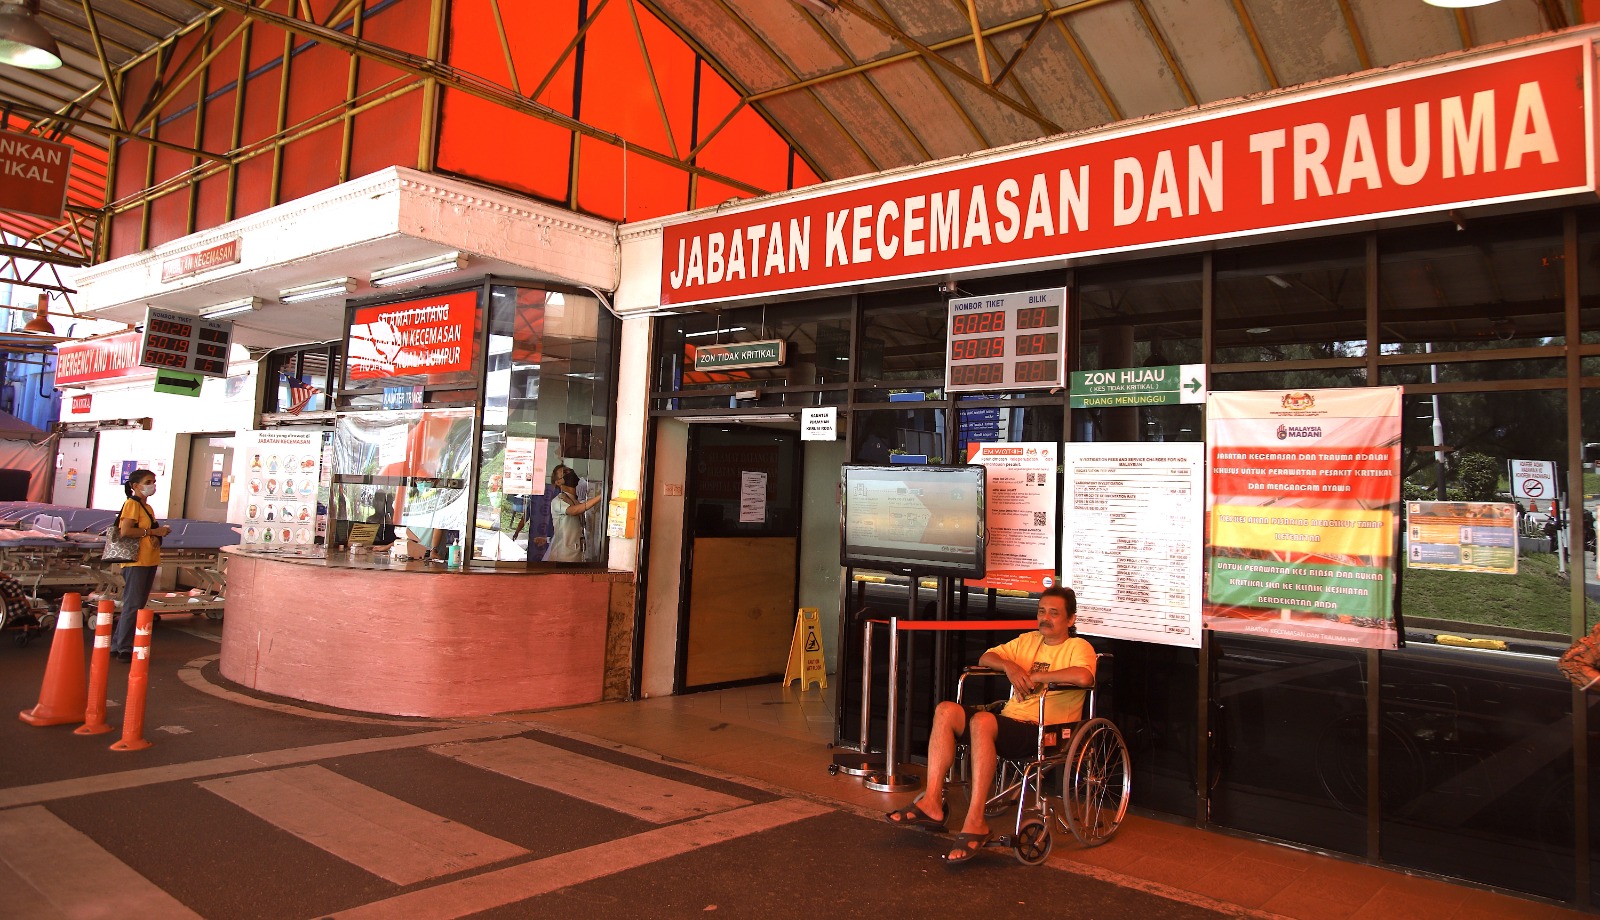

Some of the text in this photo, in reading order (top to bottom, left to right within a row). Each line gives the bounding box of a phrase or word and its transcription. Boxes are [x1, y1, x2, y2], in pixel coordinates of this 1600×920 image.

[669, 81, 1560, 290] JABATAN KECEMASAN DAN TRAUMA
[194, 245, 233, 268] KECEMASAN
[953, 295, 1047, 311] NOMBOR TIKET BILIK
[150, 319, 191, 337] 6028
[953, 311, 1005, 335] 6028
[409, 324, 462, 347] KECEMASAN
[147, 334, 217, 356] 5019 4
[953, 335, 1045, 359] 5019 4
[58, 341, 137, 378] EMERGENCY AND TRAUMA
[145, 350, 213, 372] 6023 6
[700, 349, 776, 363] ZON TIDAK KRITIKAL
[1084, 369, 1165, 386] ZON HIJAU
[1083, 395, 1166, 406] RUANG MENUNGGU
[1216, 452, 1389, 461] JABATAN KECEMASAN DAN TRAUMA ADALAH
[1268, 468, 1317, 476] PERAWATAN
[1354, 469, 1393, 477] KRITIKAL
[1248, 482, 1265, 490] DAN
[1267, 483, 1320, 491] MENGANCAM
[1271, 517, 1309, 526] DISARING
[1311, 519, 1356, 528] MENGIKUT
[1217, 562, 1384, 581] UNTUK PERAWATAN KES BIASA DAN BUKAN
[1229, 578, 1369, 596] KRITIKAL SILA KE KLINIK KESIHATAN
[1258, 596, 1337, 609] BERDEKATAN ANDA
[1244, 625, 1269, 633] JABATAN
[1270, 628, 1306, 638] KECEMASAN
[1320, 633, 1347, 642] TRAUMA
